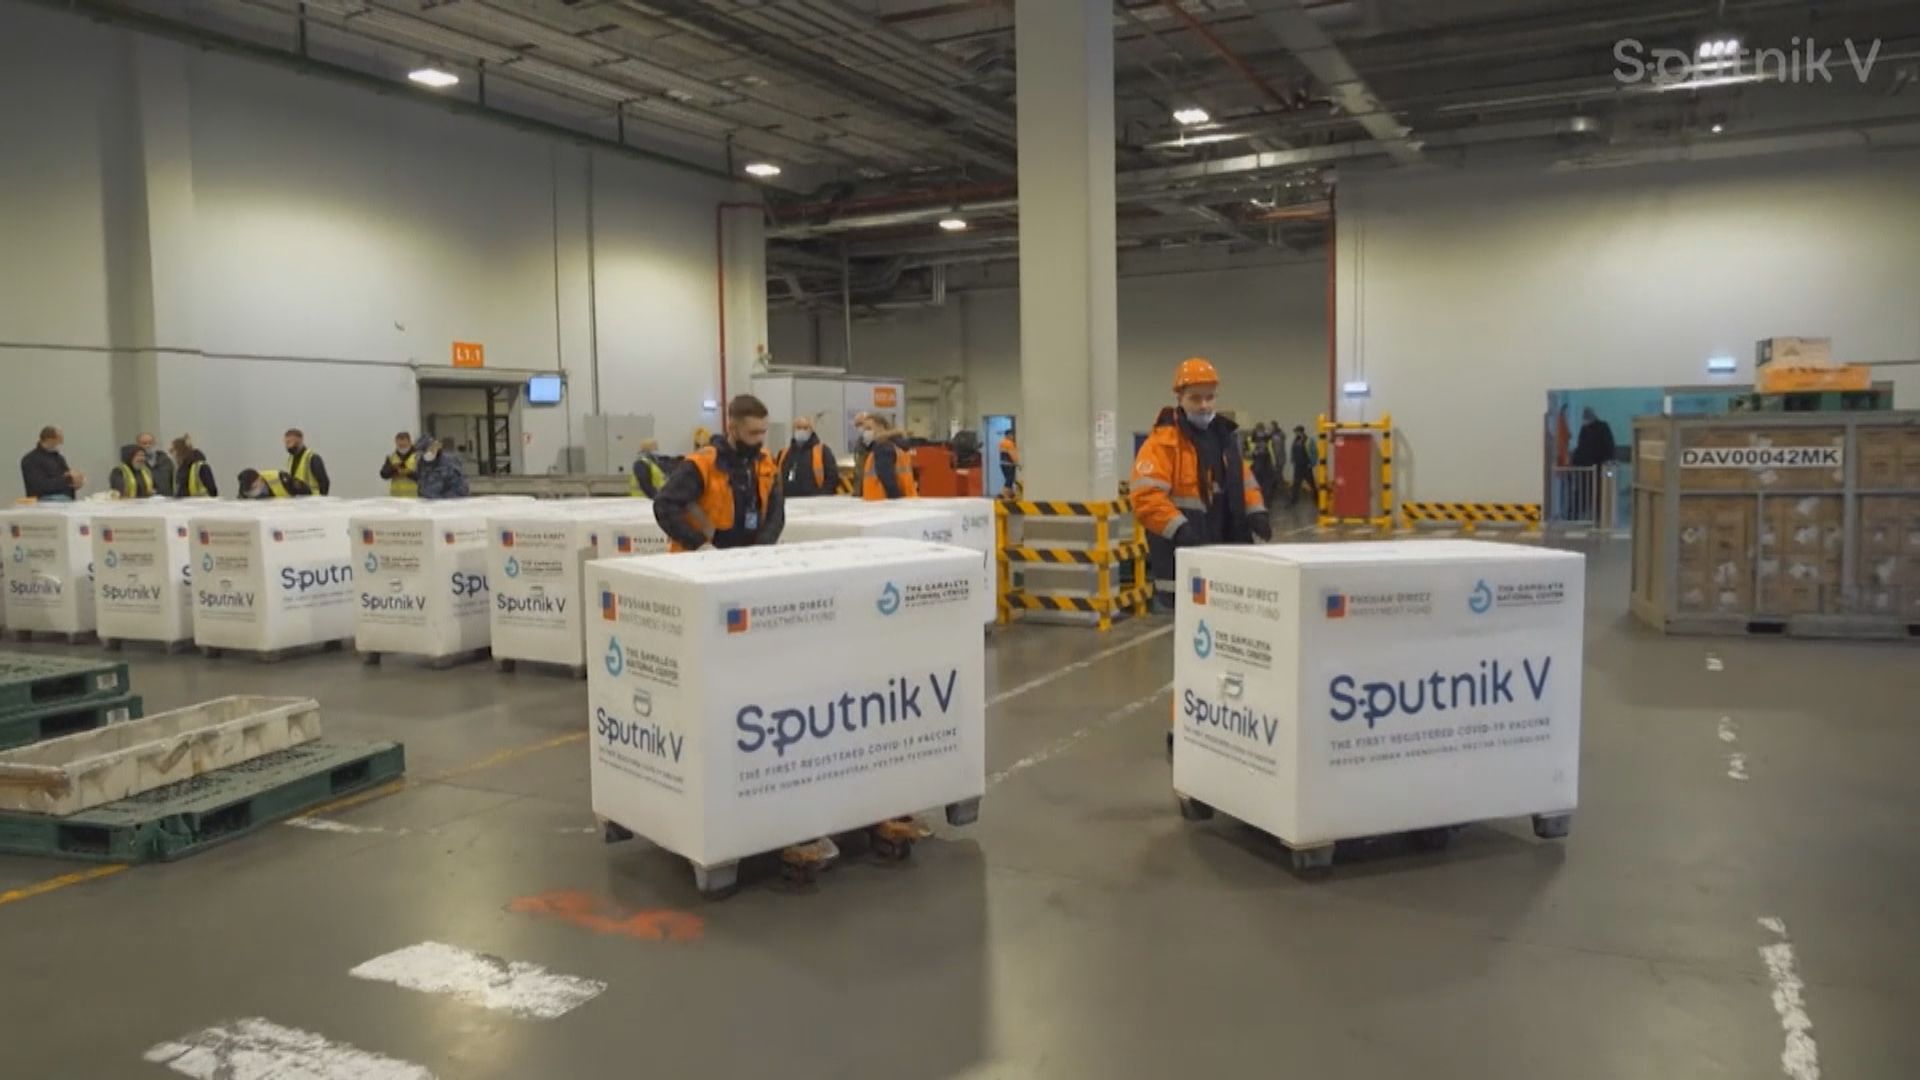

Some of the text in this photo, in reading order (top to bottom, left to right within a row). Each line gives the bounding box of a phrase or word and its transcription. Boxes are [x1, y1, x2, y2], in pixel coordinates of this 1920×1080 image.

[1683, 450, 1838, 465] DAV00042MK
[151, 585, 161, 600] V
[246, 592, 255, 607] V
[1209, 580, 1279, 603] RUSSIAN DIRECT
[416, 597, 426, 611] V
[556, 598, 566, 613] V
[800, 597, 834, 611] DIRECT
[1523, 656, 1551, 700] V
[929, 669, 957, 713] V
[1263, 713, 1278, 746] V
[1331, 739, 1351, 751] THE
[1355, 734, 1385, 747] FIRST
[1390, 727, 1454, 744] REGISTERED
[669, 731, 683, 763] V
[740, 768, 760, 780] THE
[765, 760, 798, 775] FIRST
[801, 748, 865, 768] REGISTERED
